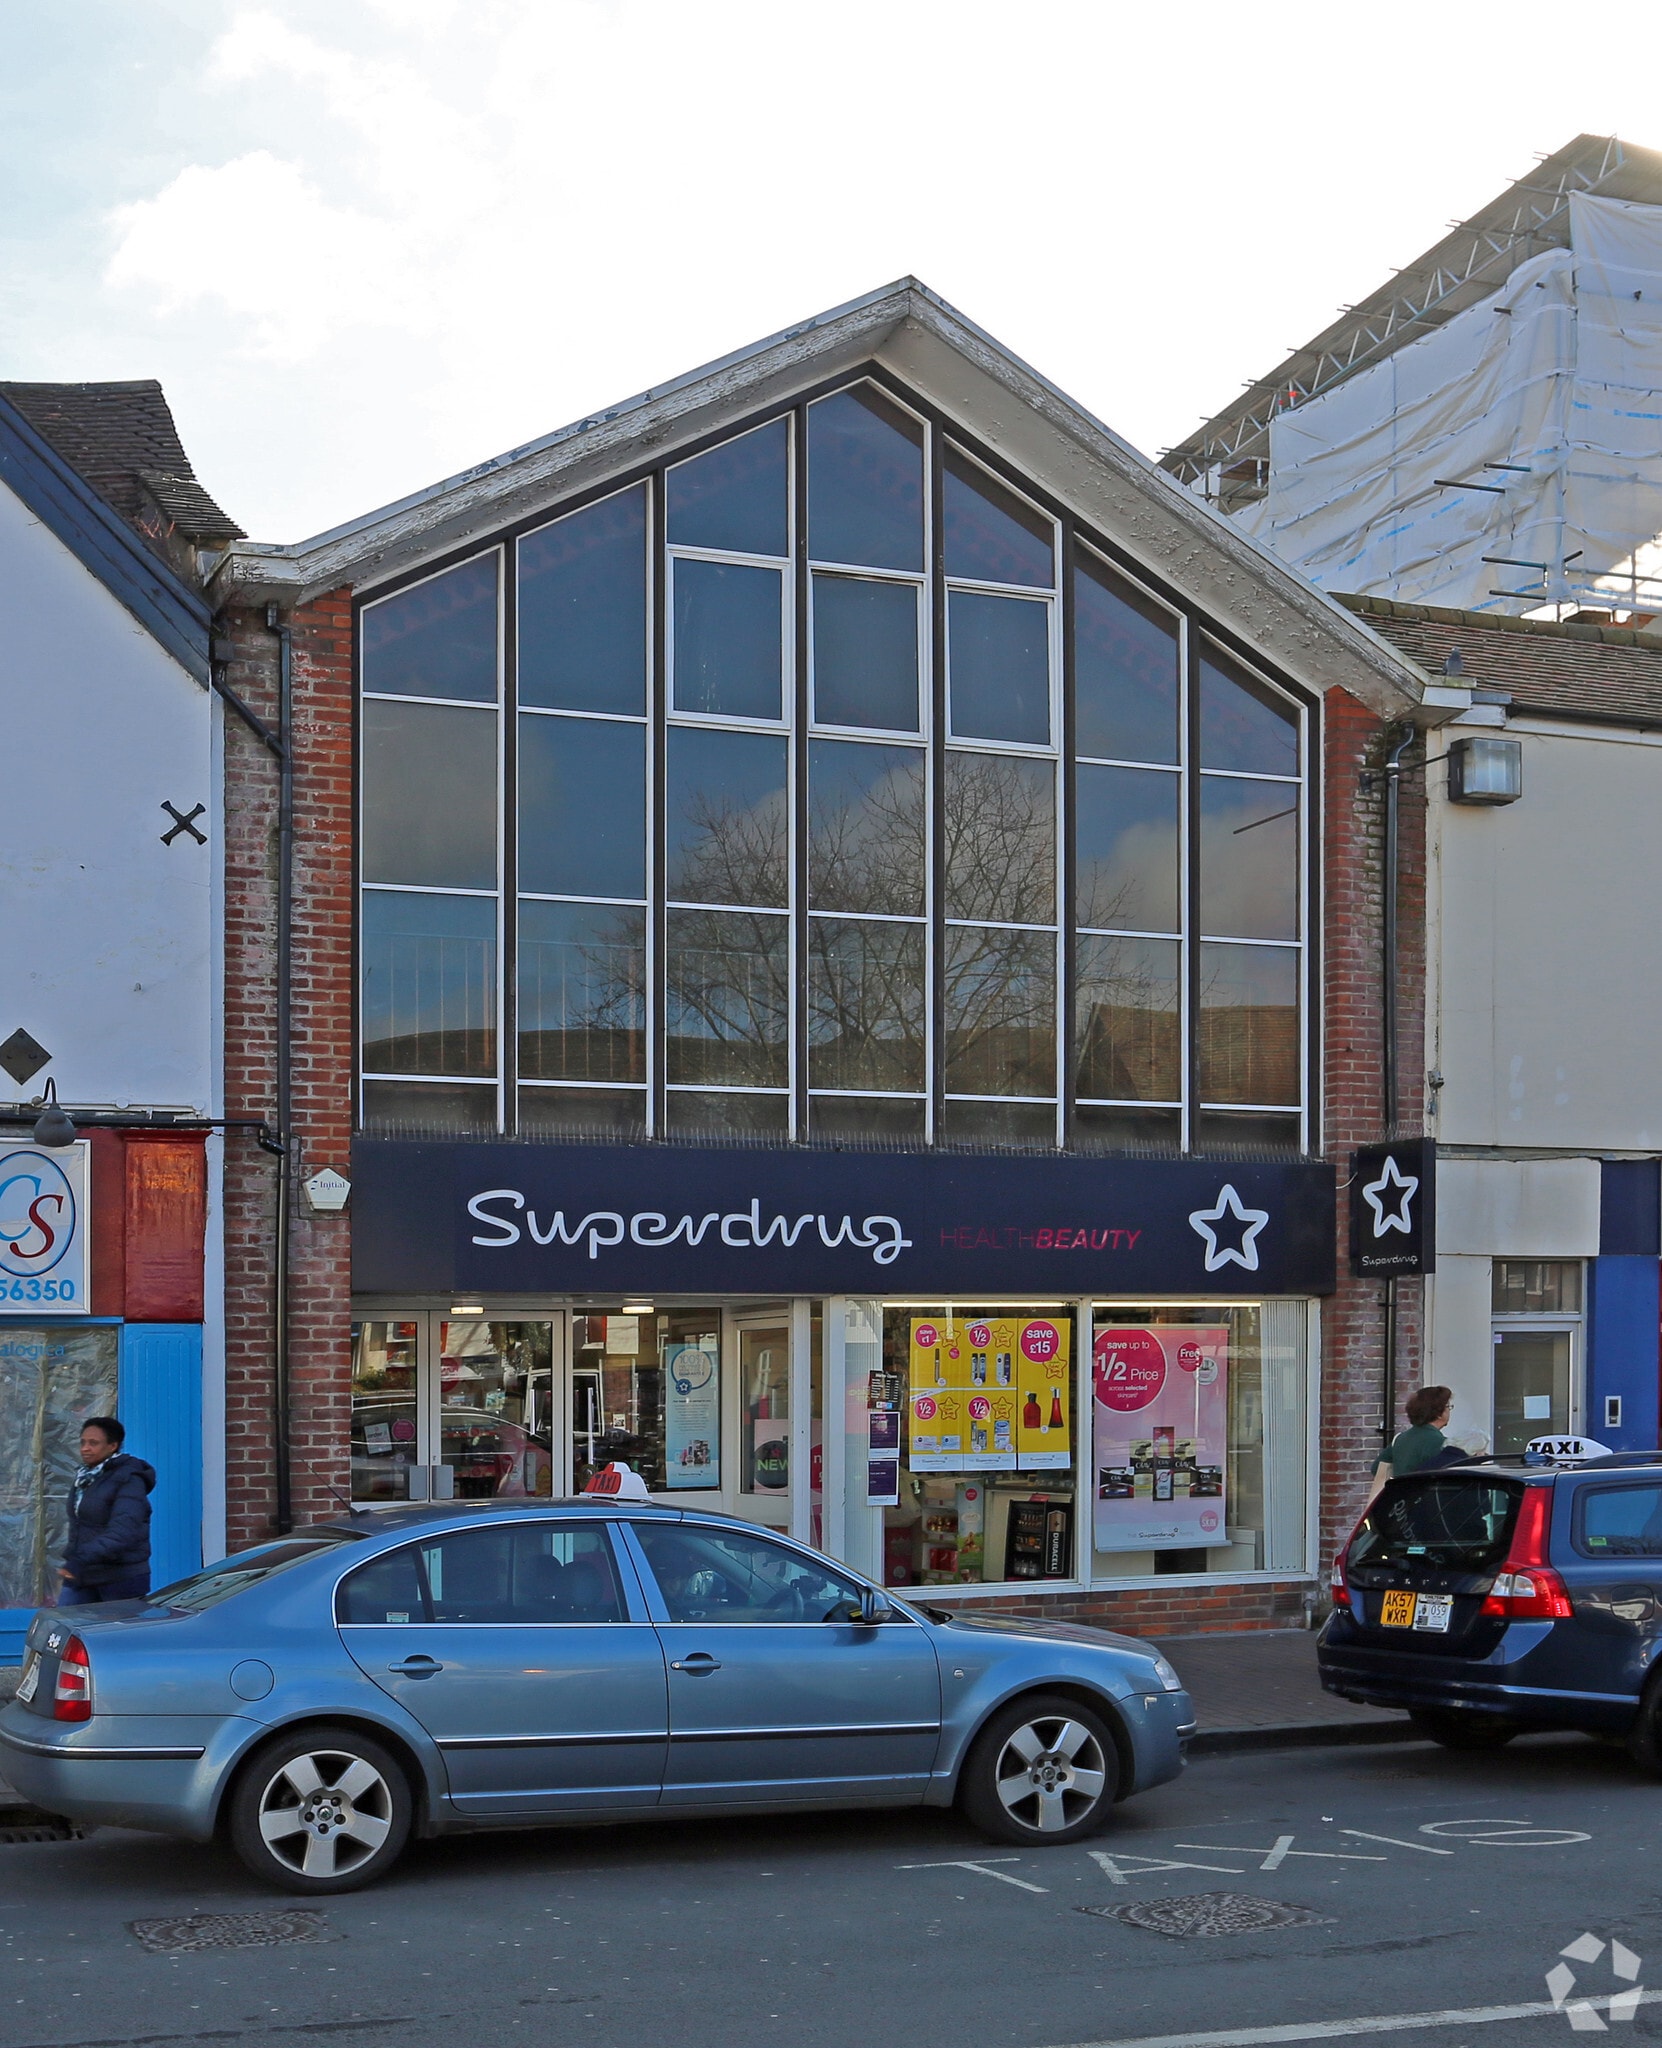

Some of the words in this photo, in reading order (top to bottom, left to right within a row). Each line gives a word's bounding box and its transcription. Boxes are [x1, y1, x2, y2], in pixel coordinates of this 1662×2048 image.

[320, 1181, 346, 1189] Initial
[467, 1189, 913, 1265] Superdrug
[1361, 1254, 1418, 1267] Superdrug
[1026, 1329, 1054, 1339] save
[1029, 1341, 1051, 1354] £15
[1106, 1342, 1128, 1350] save
[1141, 1341, 1150, 1349] to
[1180, 1348, 1200, 1358] Free
[1097, 1352, 1127, 1381] 1/2
[1130, 1368, 1159, 1381] Price
[1529, 1441, 1580, 1454] TAXI
[593, 1473, 617, 1491] TAXI
[1051, 1532, 1060, 1571] DURACELL
[1384, 1592, 1413, 1607] AK57
[1386, 1607, 1408, 1624] WXR
[1430, 1604, 1447, 1616] 059
[893, 1819, 1593, 1892] TAXIS
